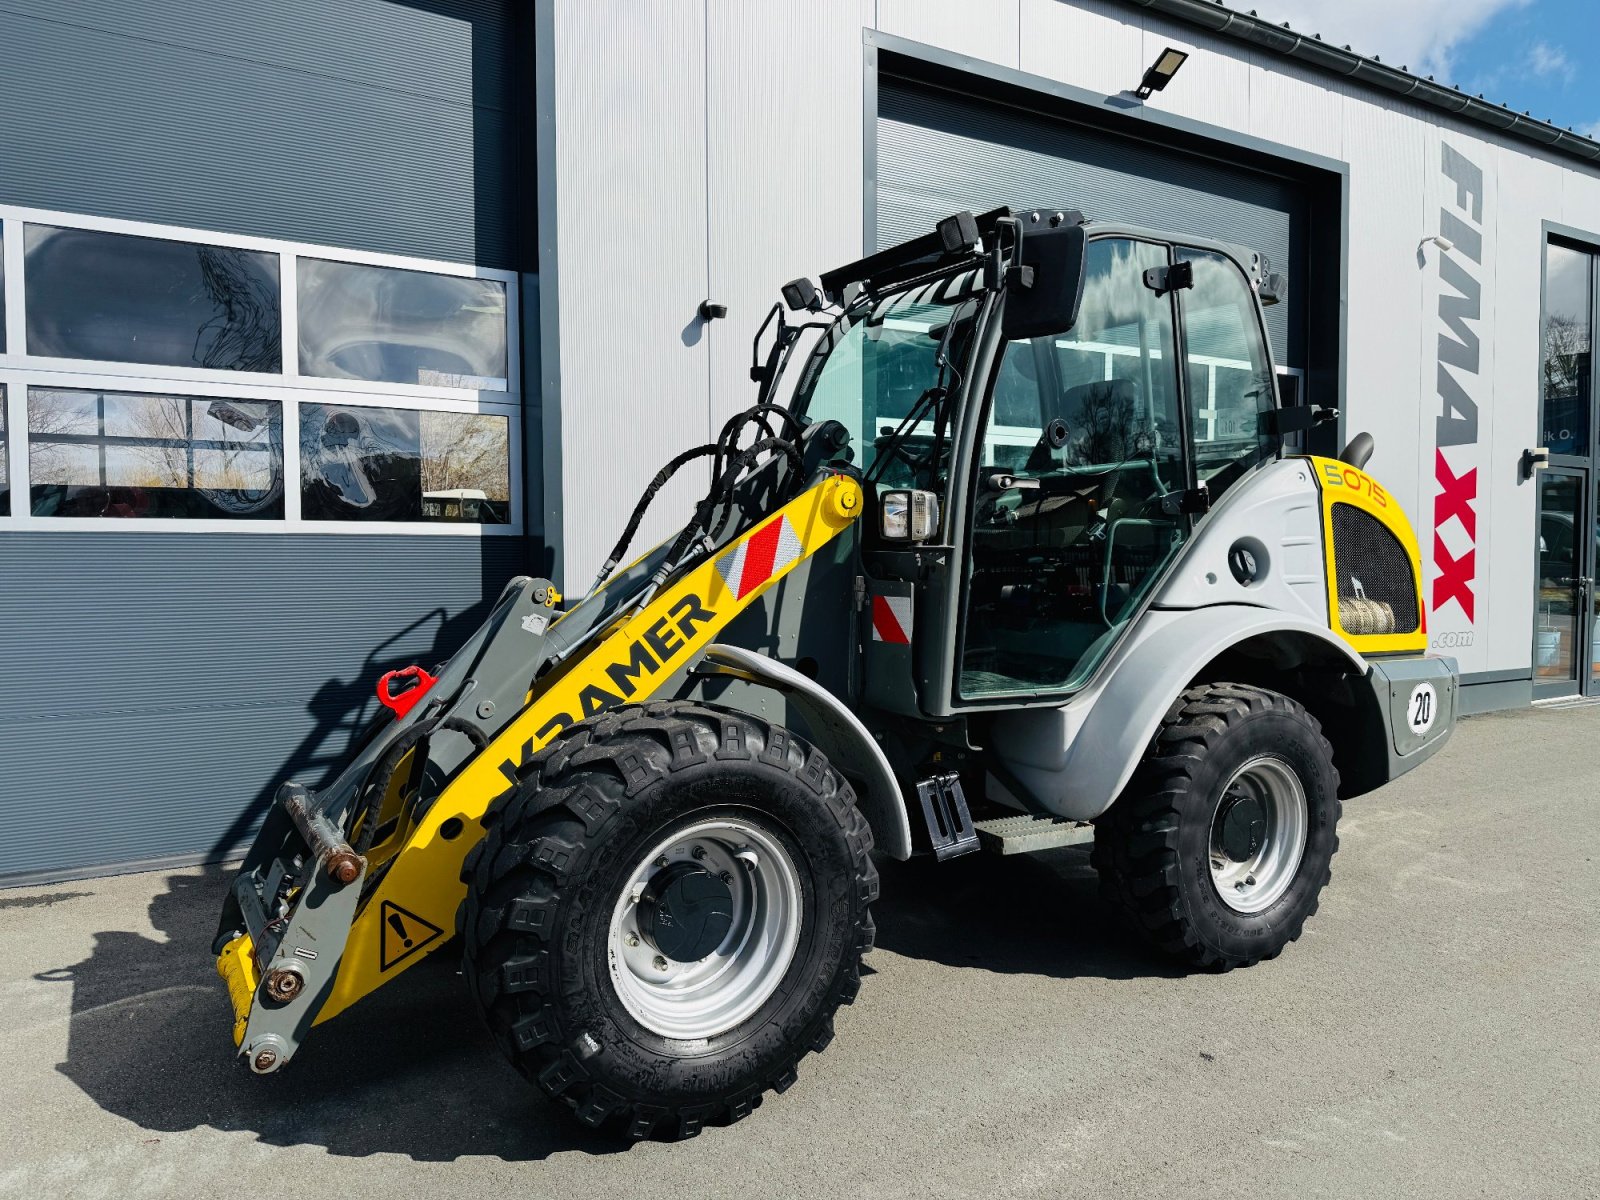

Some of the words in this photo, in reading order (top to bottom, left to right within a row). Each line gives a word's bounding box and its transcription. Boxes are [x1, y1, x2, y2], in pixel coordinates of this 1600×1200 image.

[1324, 464, 1387, 508] 5075
[1432, 631, 1474, 648] .com
[1414, 691, 1431, 726] 20
